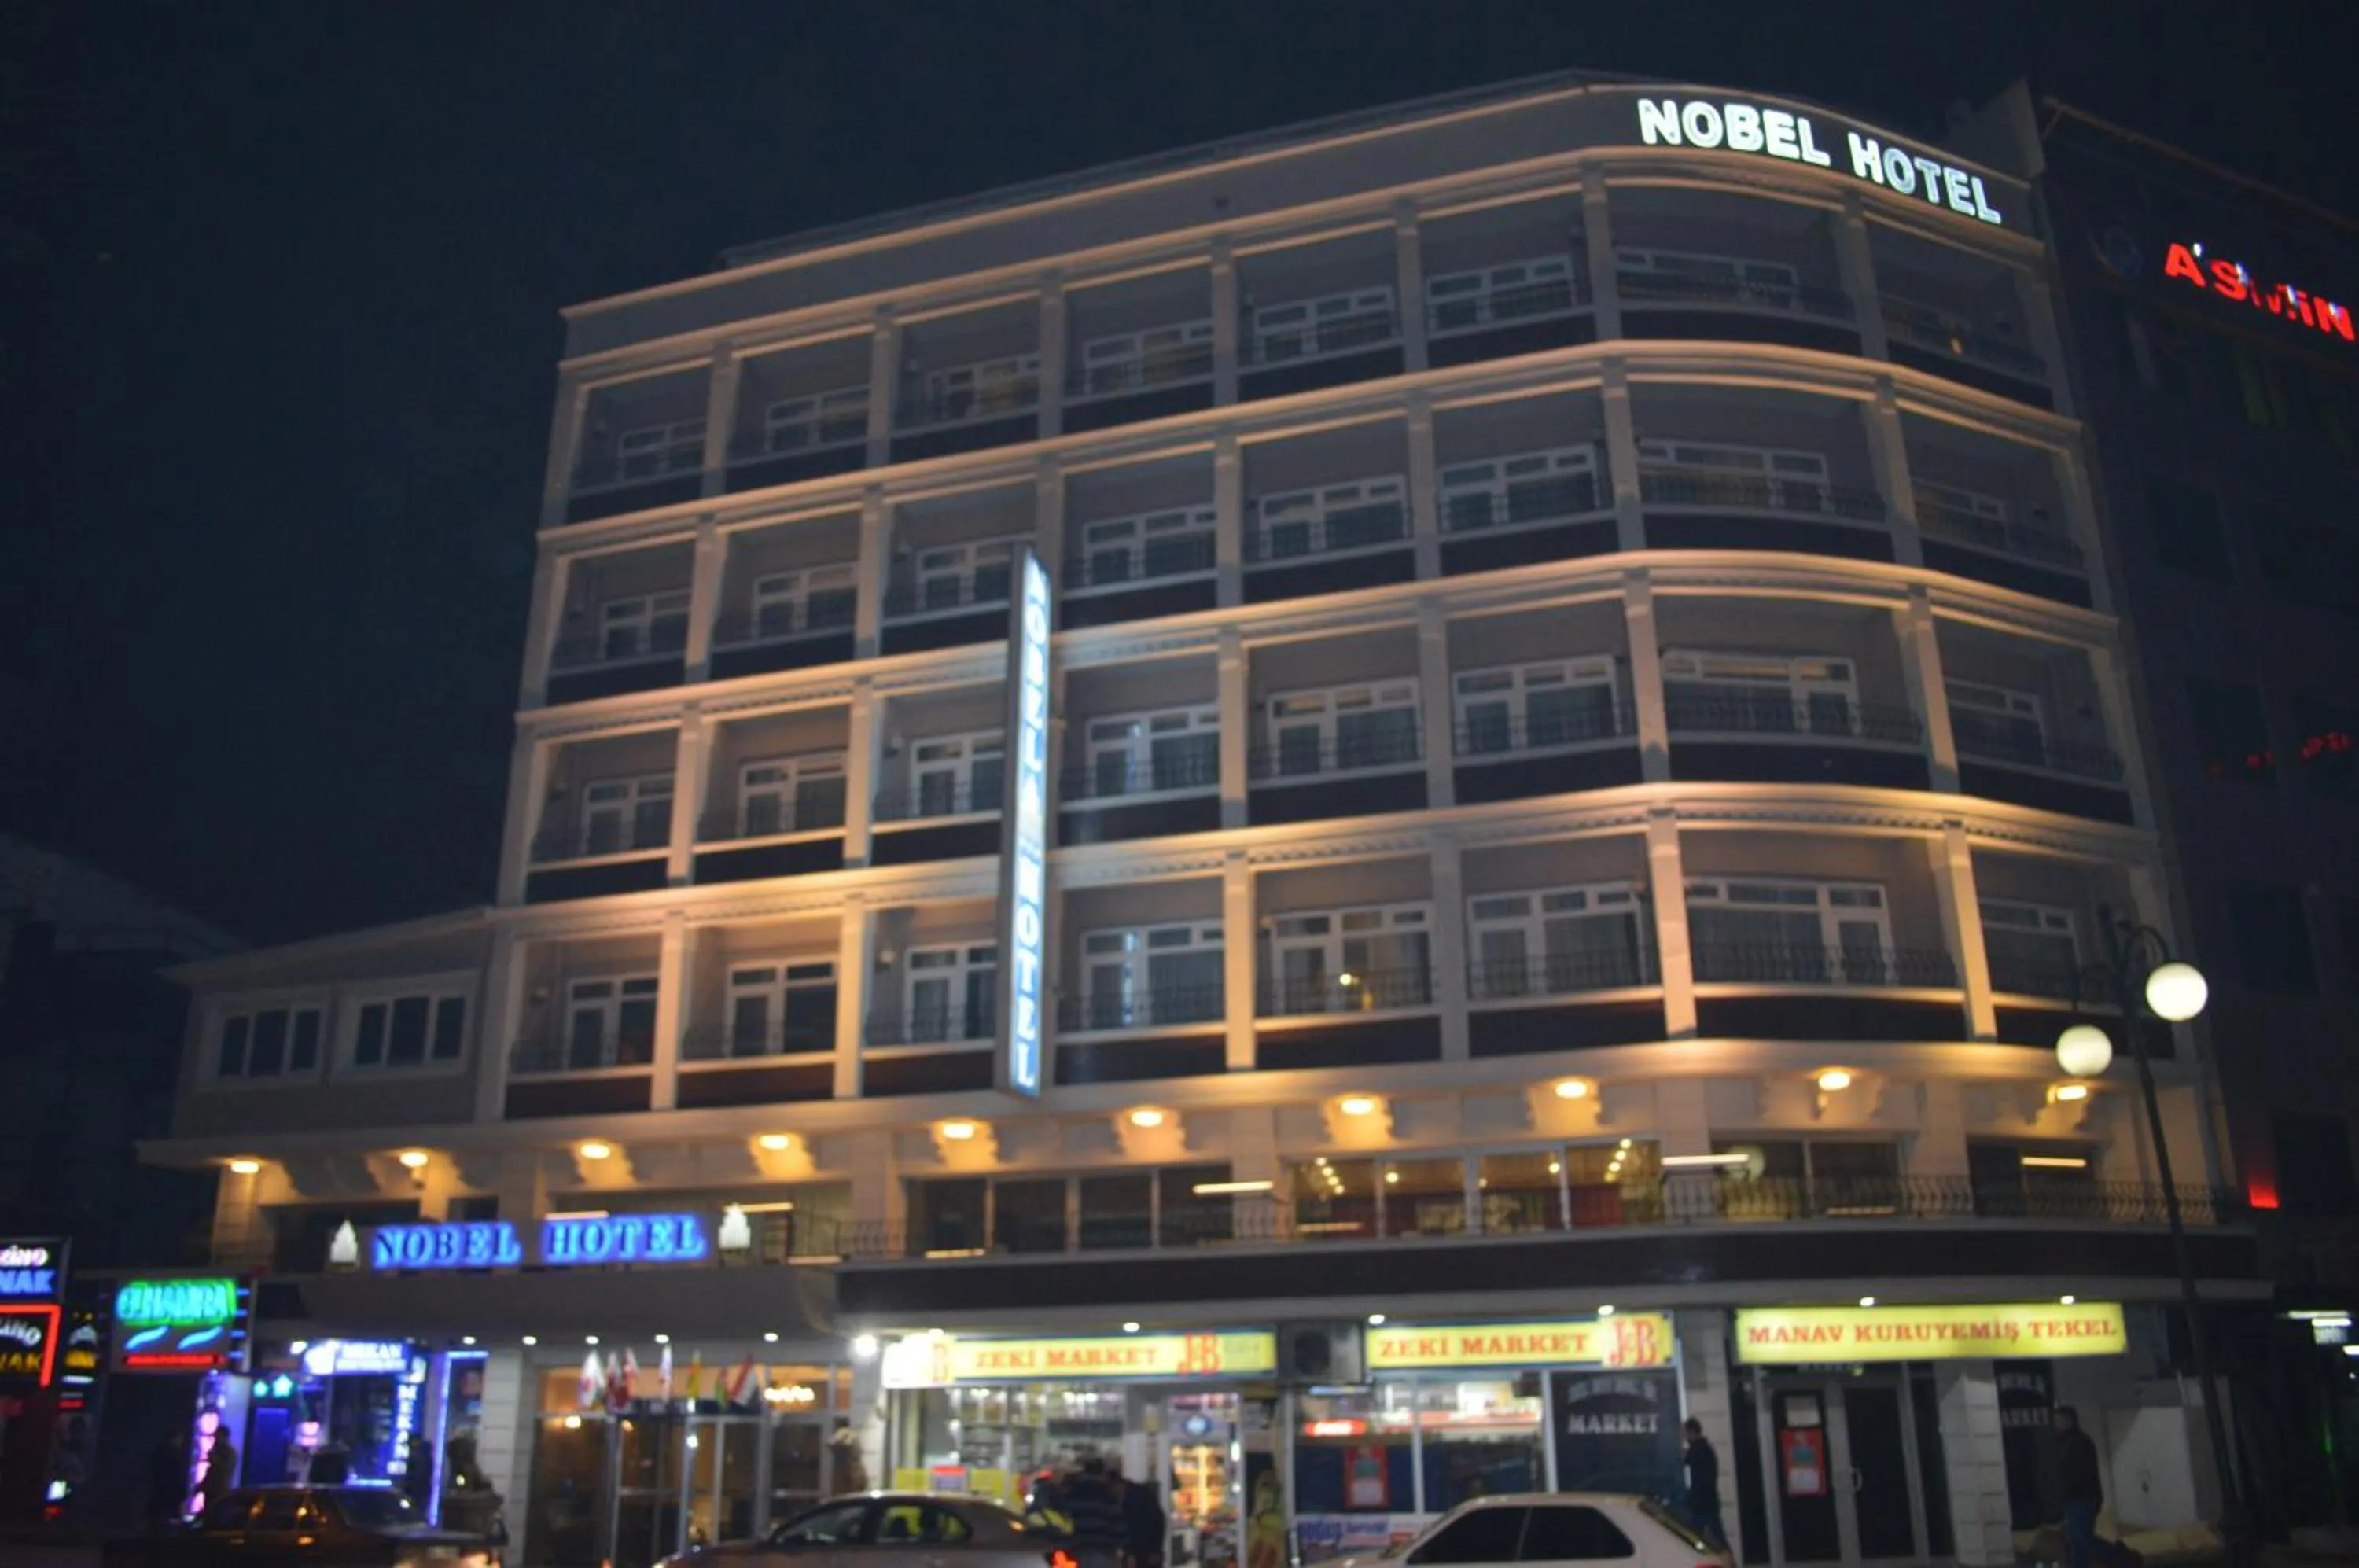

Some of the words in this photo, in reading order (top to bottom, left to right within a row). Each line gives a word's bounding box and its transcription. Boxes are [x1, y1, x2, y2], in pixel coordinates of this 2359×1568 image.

[1637, 99, 1831, 165] NOBEL
[1848, 132, 2002, 224] HOTEL
[373, 1224, 521, 1269] NOBEL
[544, 1213, 706, 1263] HOTEL
[1747, 1326, 1844, 1344] MANAV
[1854, 1320, 2020, 1343] KURUYEMİŞ
[2027, 1319, 2117, 1338] TEKEL
[1461, 1333, 1590, 1355] MARKET
[1047, 1347, 1158, 1367] MARKET
[1567, 1413, 1661, 1434] MARKET
